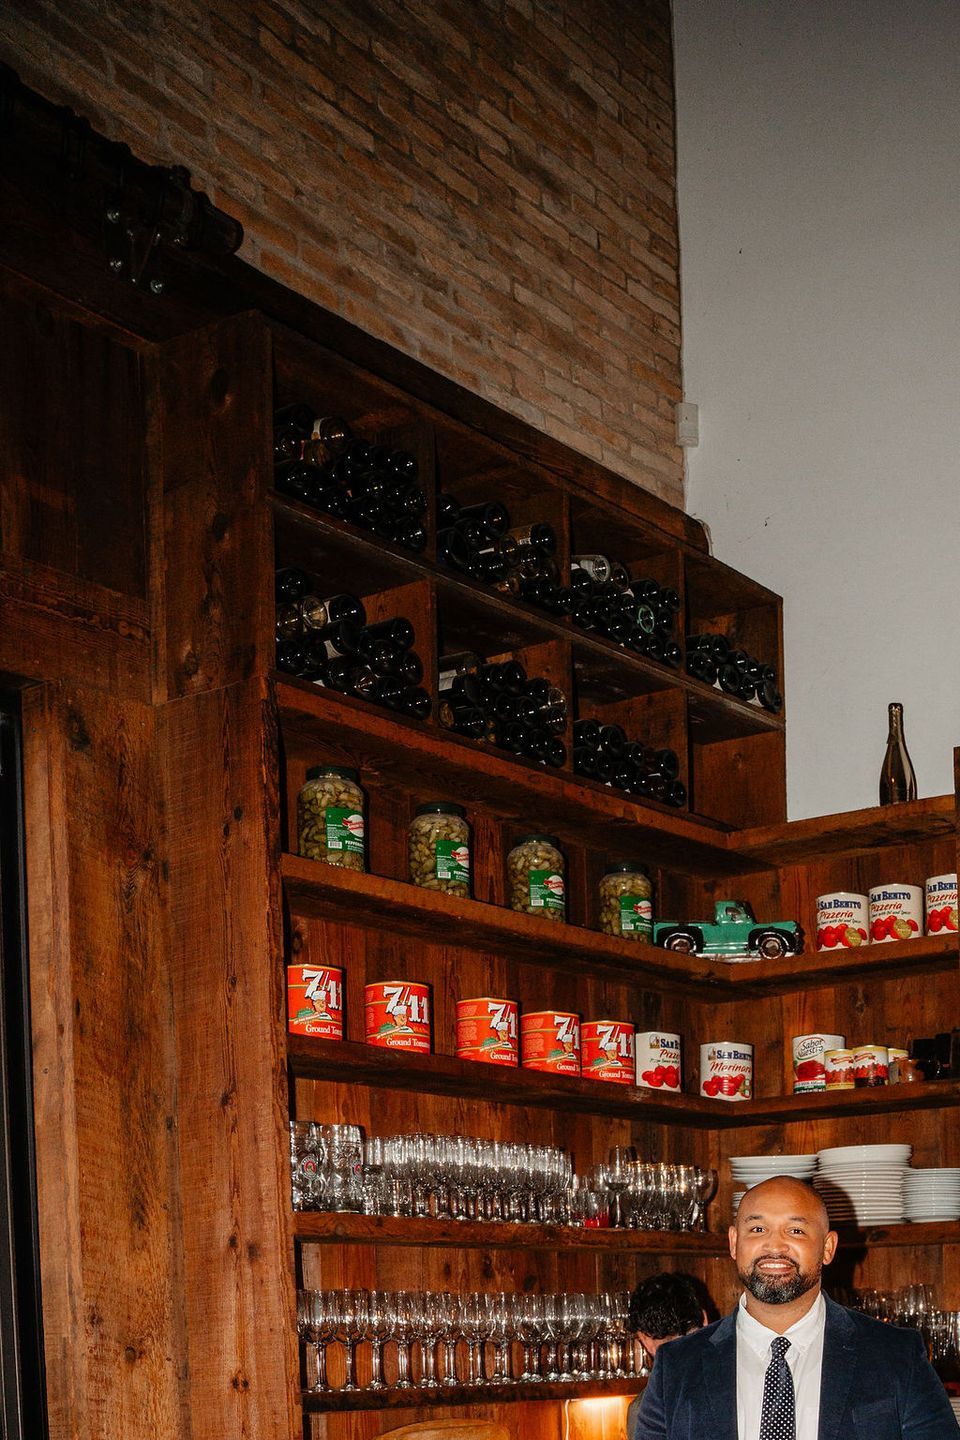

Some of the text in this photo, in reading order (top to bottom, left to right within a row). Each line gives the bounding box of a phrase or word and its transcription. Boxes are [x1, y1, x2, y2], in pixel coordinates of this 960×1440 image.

[881, 891, 911, 901] BENITO
[820, 899, 861, 910] SAN BENITO
[871, 902, 902, 912] Pizzeria
[820, 911, 853, 920] Pizzeria
[382, 986, 429, 1024] 7/11
[305, 1023, 331, 1034] Ground
[386, 1038, 411, 1046] Ground
[661, 1038, 674, 1048] SAN
[802, 1039, 822, 1050] Sabor
[490, 1051, 511, 1061] Ground
[717, 1049, 732, 1059] SAN
[556, 1062, 576, 1072] Ground
[710, 1061, 752, 1073] Marinar
[599, 1070, 620, 1078] Ground
